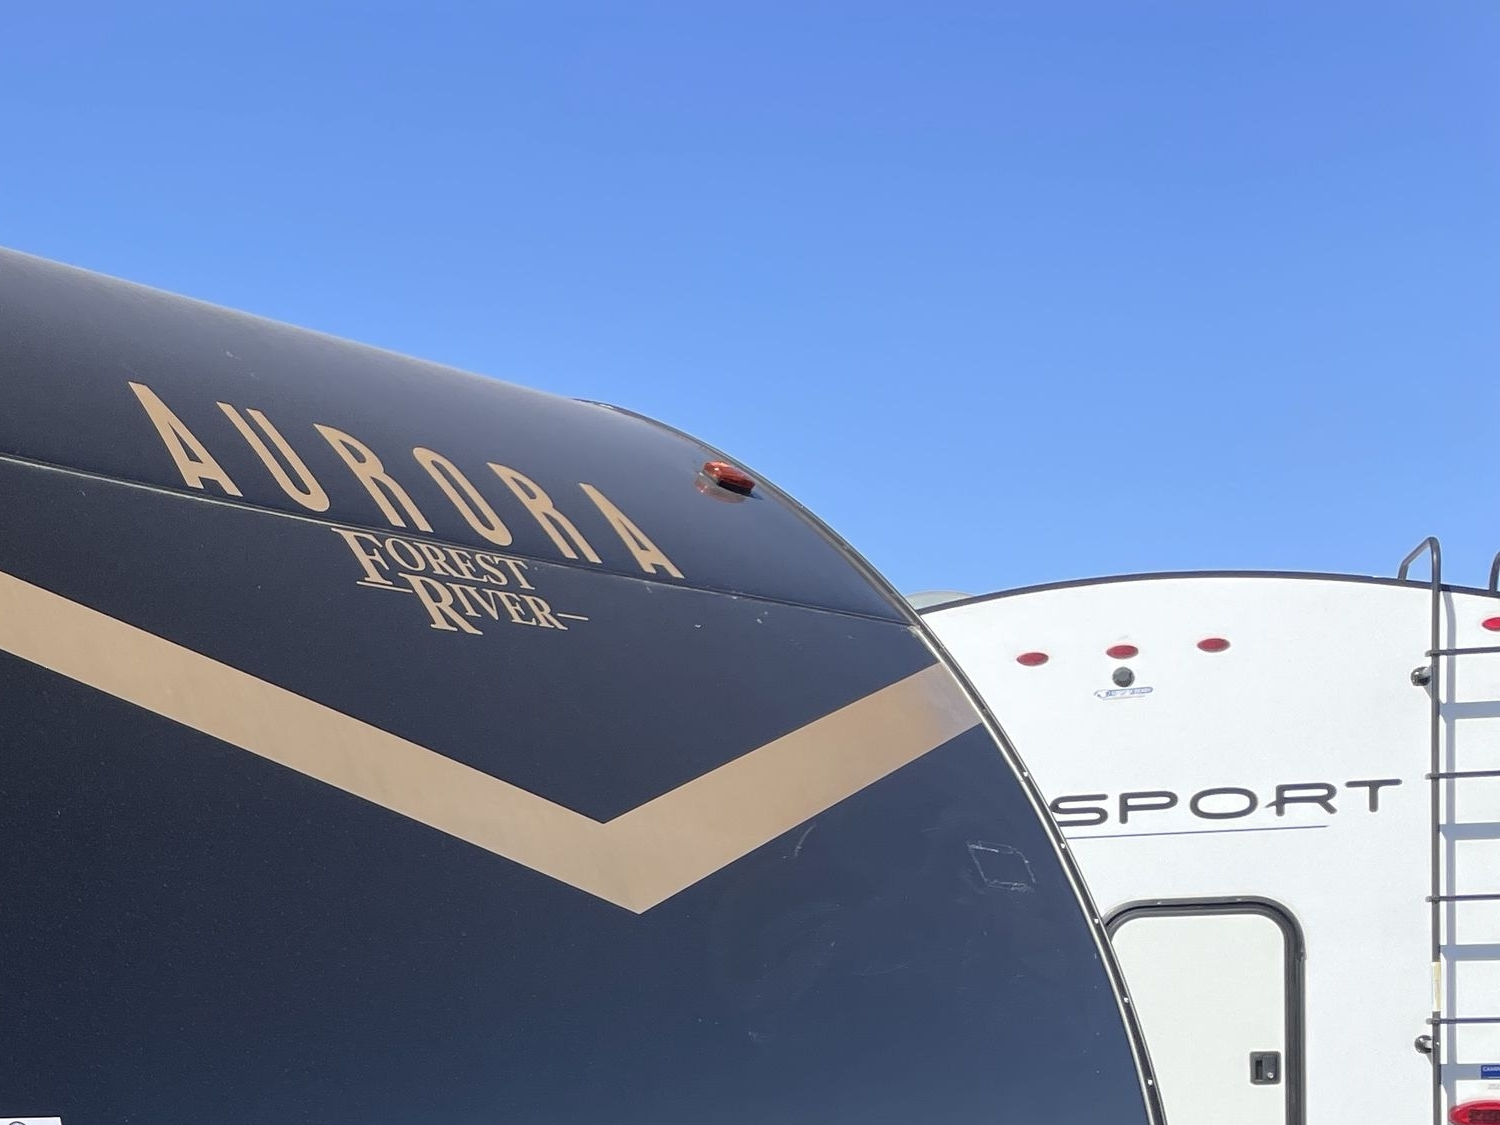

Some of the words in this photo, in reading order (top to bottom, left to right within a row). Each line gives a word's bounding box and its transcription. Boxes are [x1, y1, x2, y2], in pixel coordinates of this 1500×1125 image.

[128, 381, 684, 579] AURORA
[332, 527, 535, 590] FOREST
[398, 572, 569, 635] RIVER
[1050, 778, 1403, 827] SPORT
